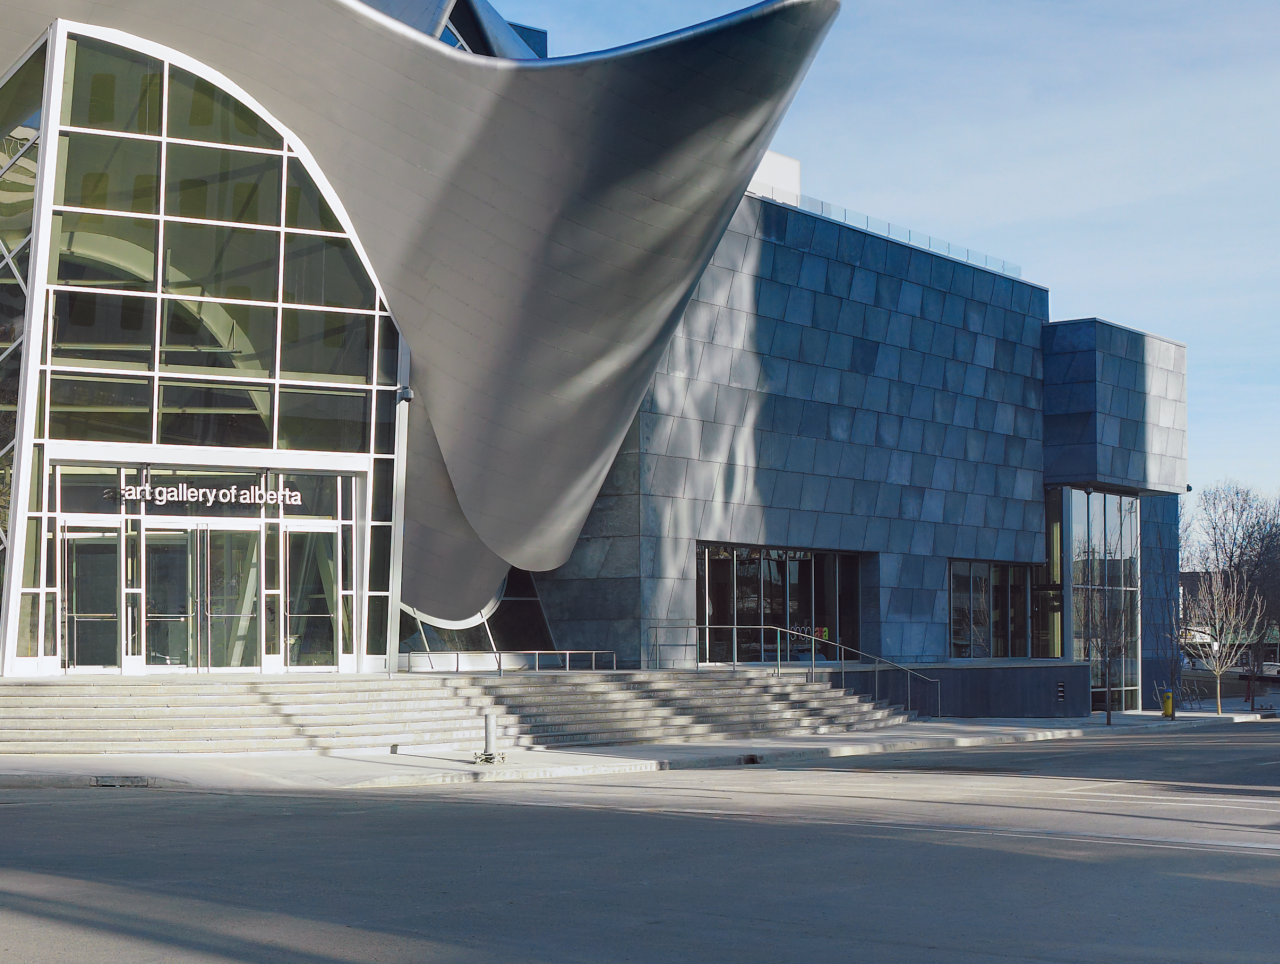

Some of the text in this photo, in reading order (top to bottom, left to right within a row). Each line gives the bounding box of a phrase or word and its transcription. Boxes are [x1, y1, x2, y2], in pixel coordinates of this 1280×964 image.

[125, 482, 302, 507] art gallery of alberta
[790, 622, 812, 644] shop
